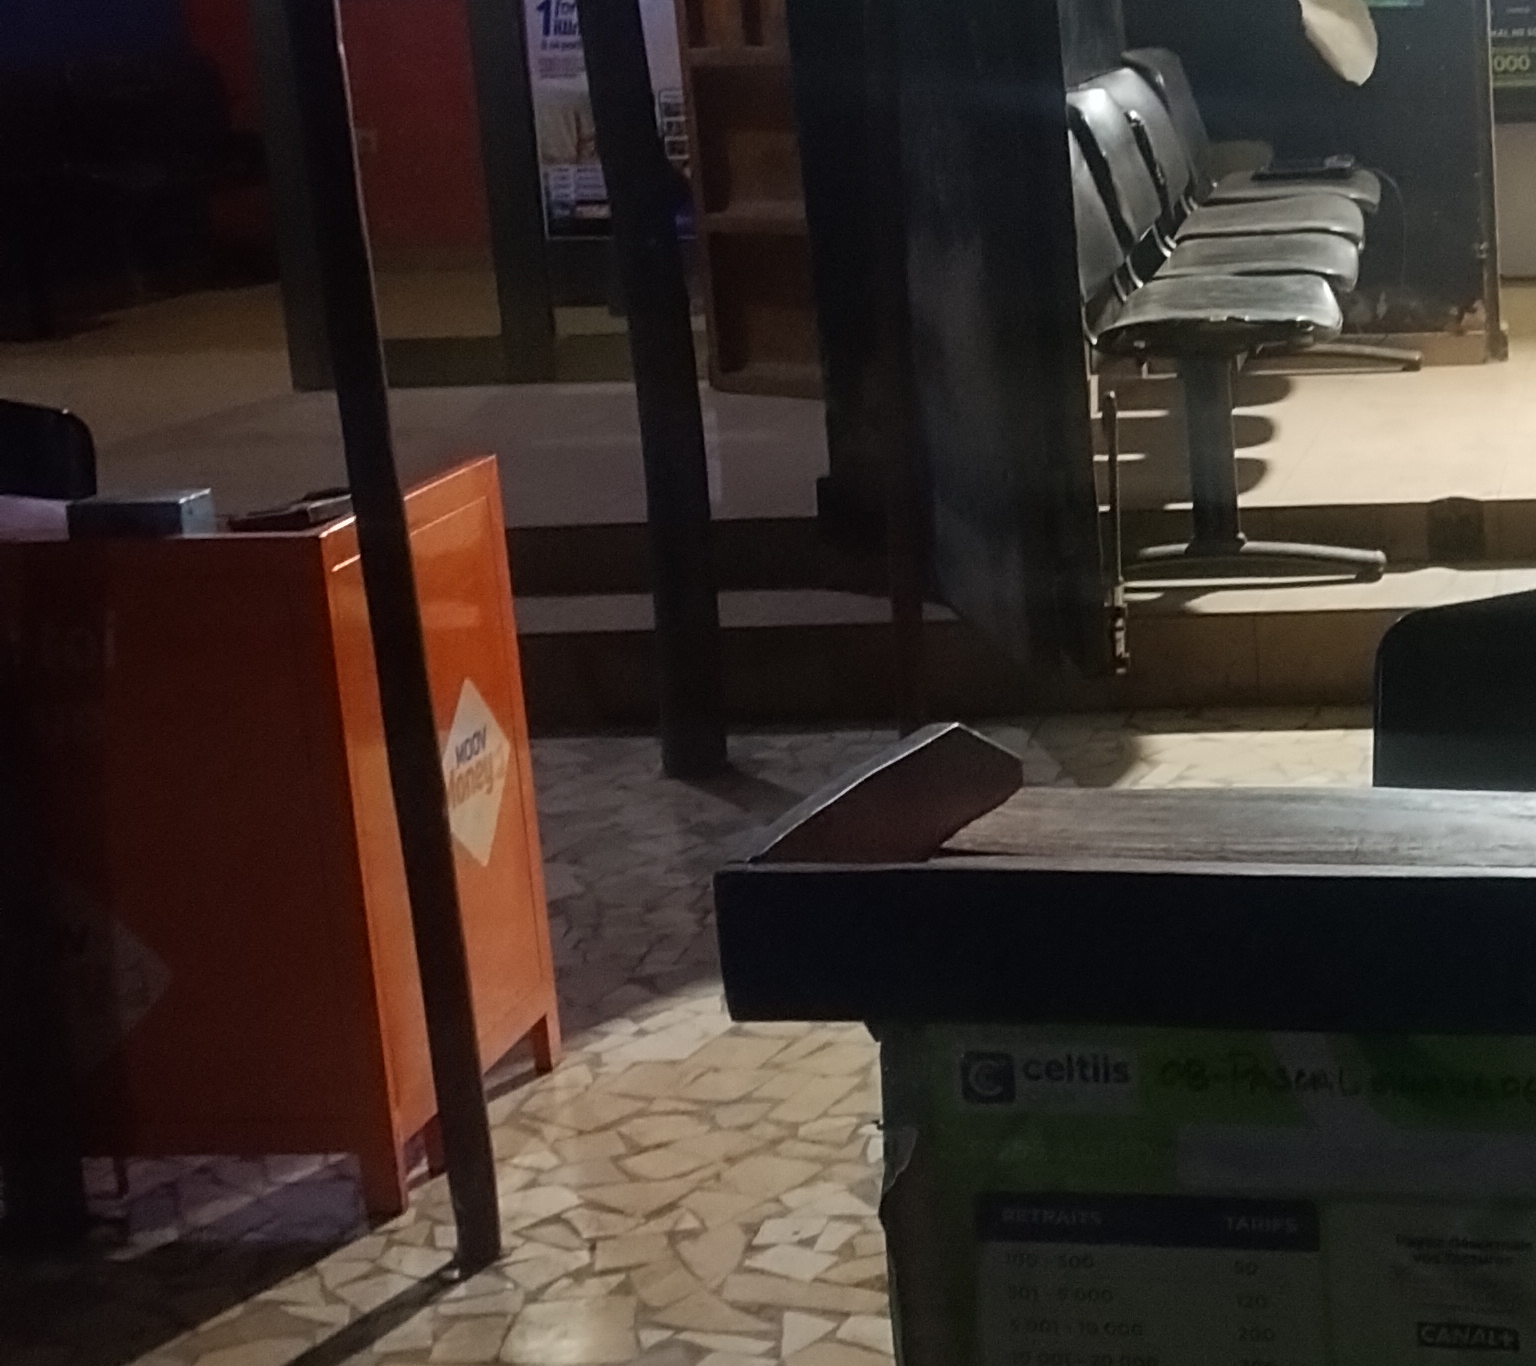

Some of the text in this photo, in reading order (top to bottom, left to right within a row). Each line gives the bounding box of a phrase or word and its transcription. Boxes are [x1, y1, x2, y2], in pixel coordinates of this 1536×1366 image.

[1022, 1052, 1130, 1084] celtiis
[1001, 1207, 1102, 1227] RETRAITS
[1224, 1214, 1298, 1234] TARIFS
[1420, 1325, 1514, 1348] CANAL+
